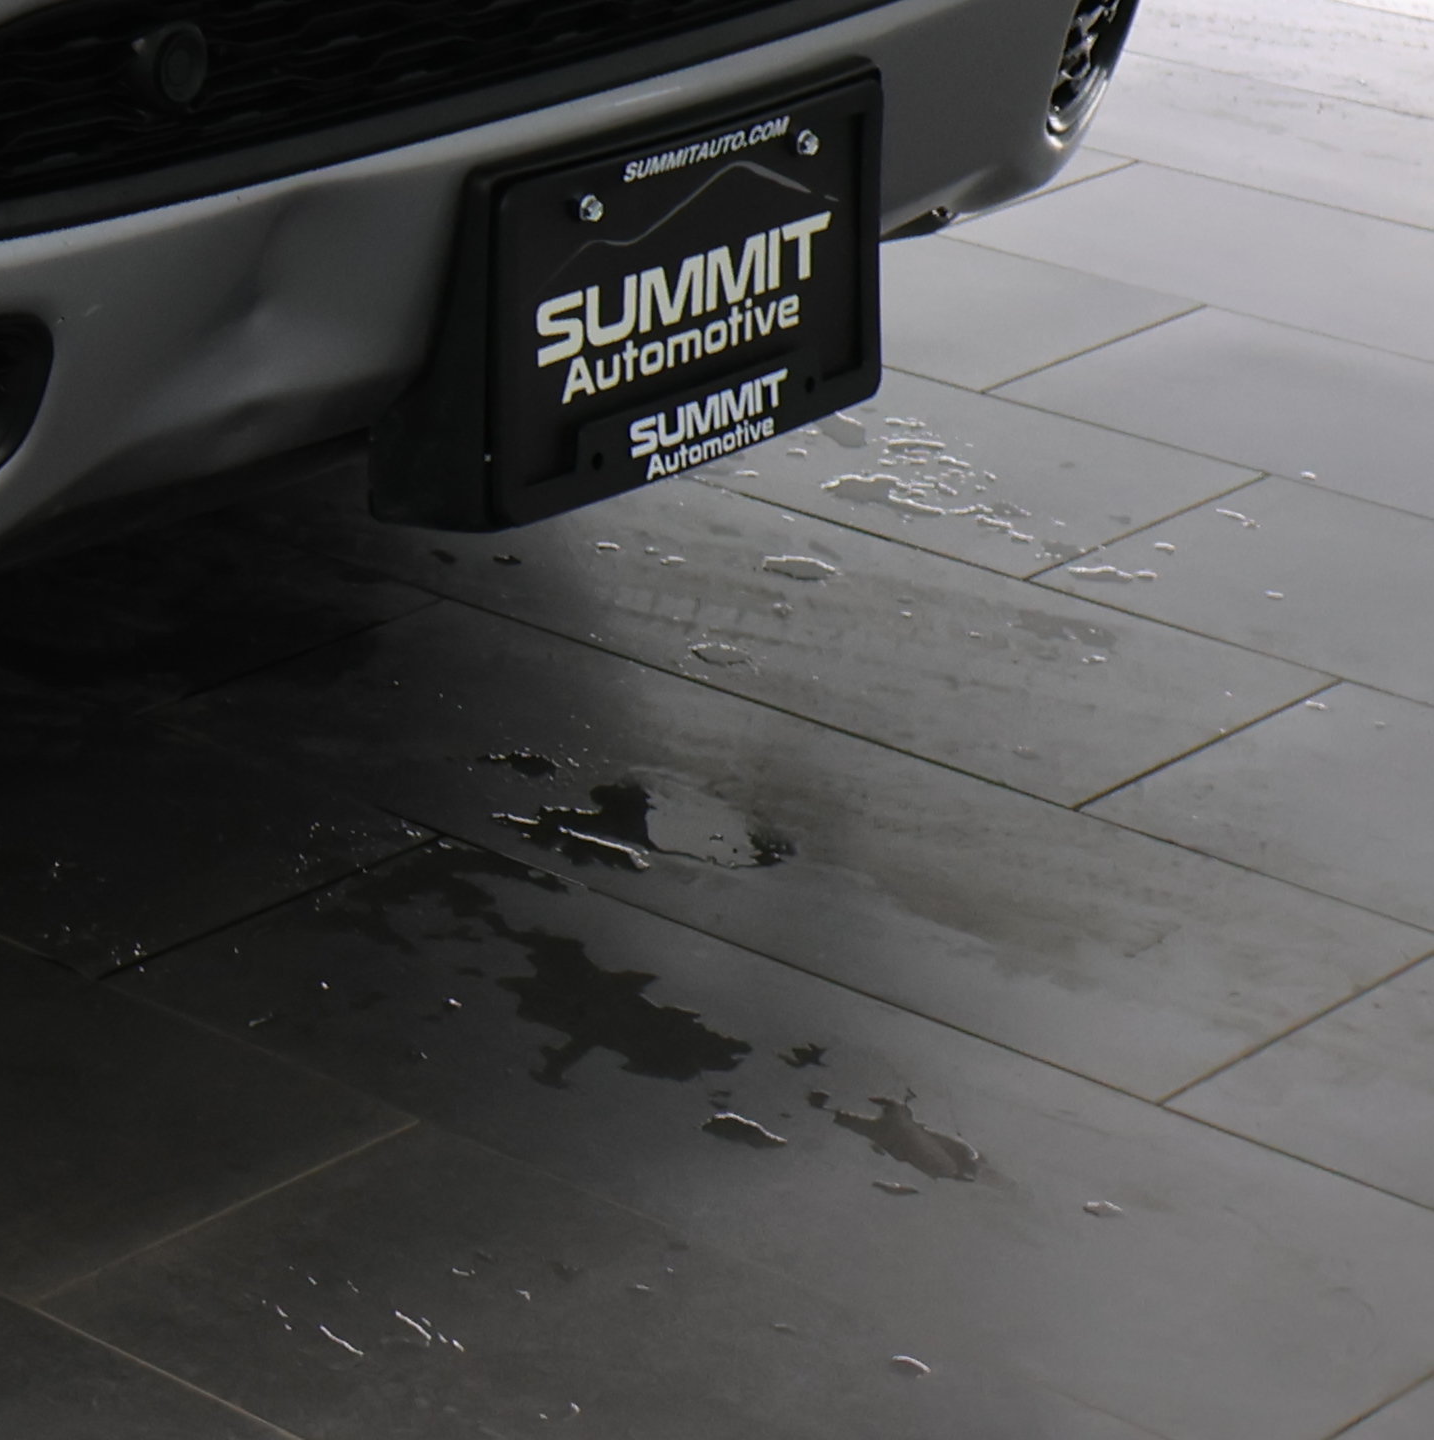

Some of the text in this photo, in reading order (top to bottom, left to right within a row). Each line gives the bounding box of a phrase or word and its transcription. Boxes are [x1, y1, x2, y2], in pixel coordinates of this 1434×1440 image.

[623, 115, 790, 183] SUMMITAUTO.COM
[536, 210, 832, 369] SUMMIT
[562, 293, 800, 404] Automotive
[629, 367, 789, 459] SUMMIT
[646, 416, 775, 481] Automotive
